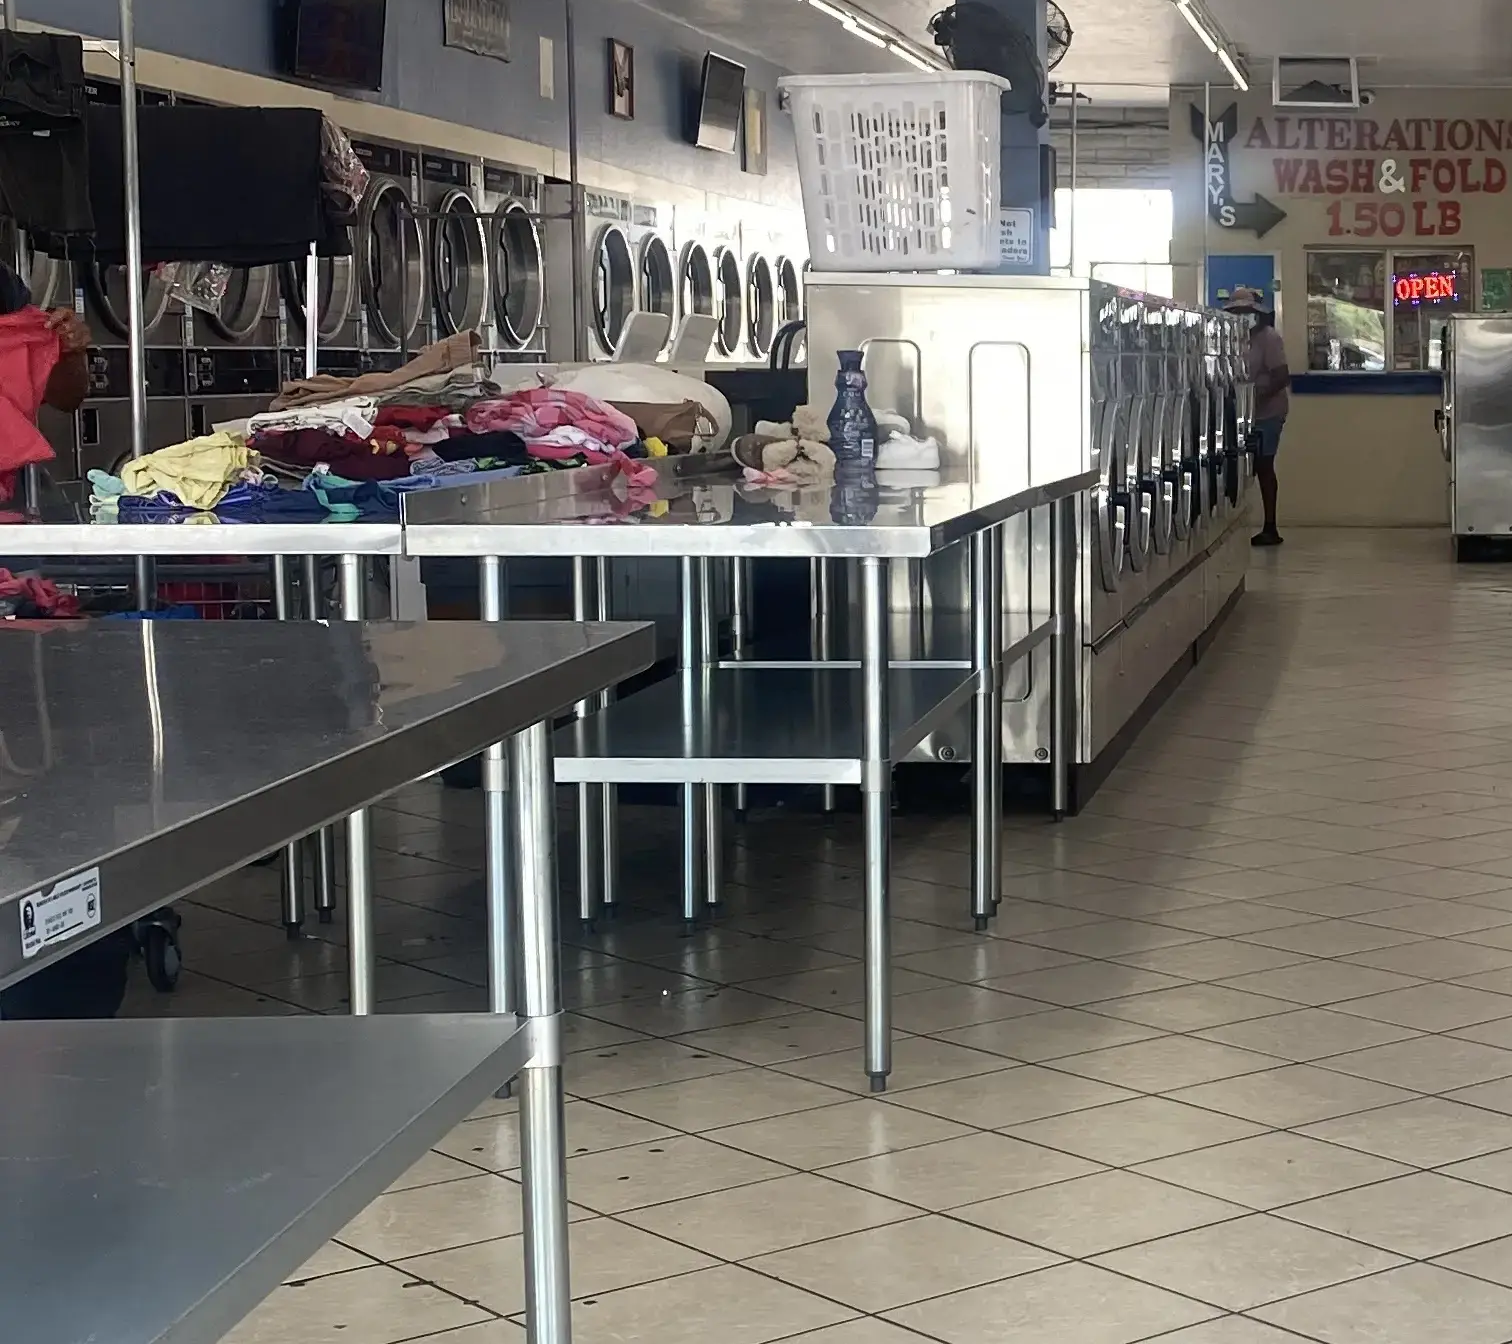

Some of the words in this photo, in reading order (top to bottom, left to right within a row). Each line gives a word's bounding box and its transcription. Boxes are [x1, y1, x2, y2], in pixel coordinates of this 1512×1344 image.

[1273, 157, 1376, 195] WASH
[1378, 158, 1406, 194] &
[1409, 157, 1508, 194] FOLD
[1326, 201, 1406, 237] 1.50
[1413, 201, 1462, 237] LB
[1396, 275, 1454, 300] OPEN
